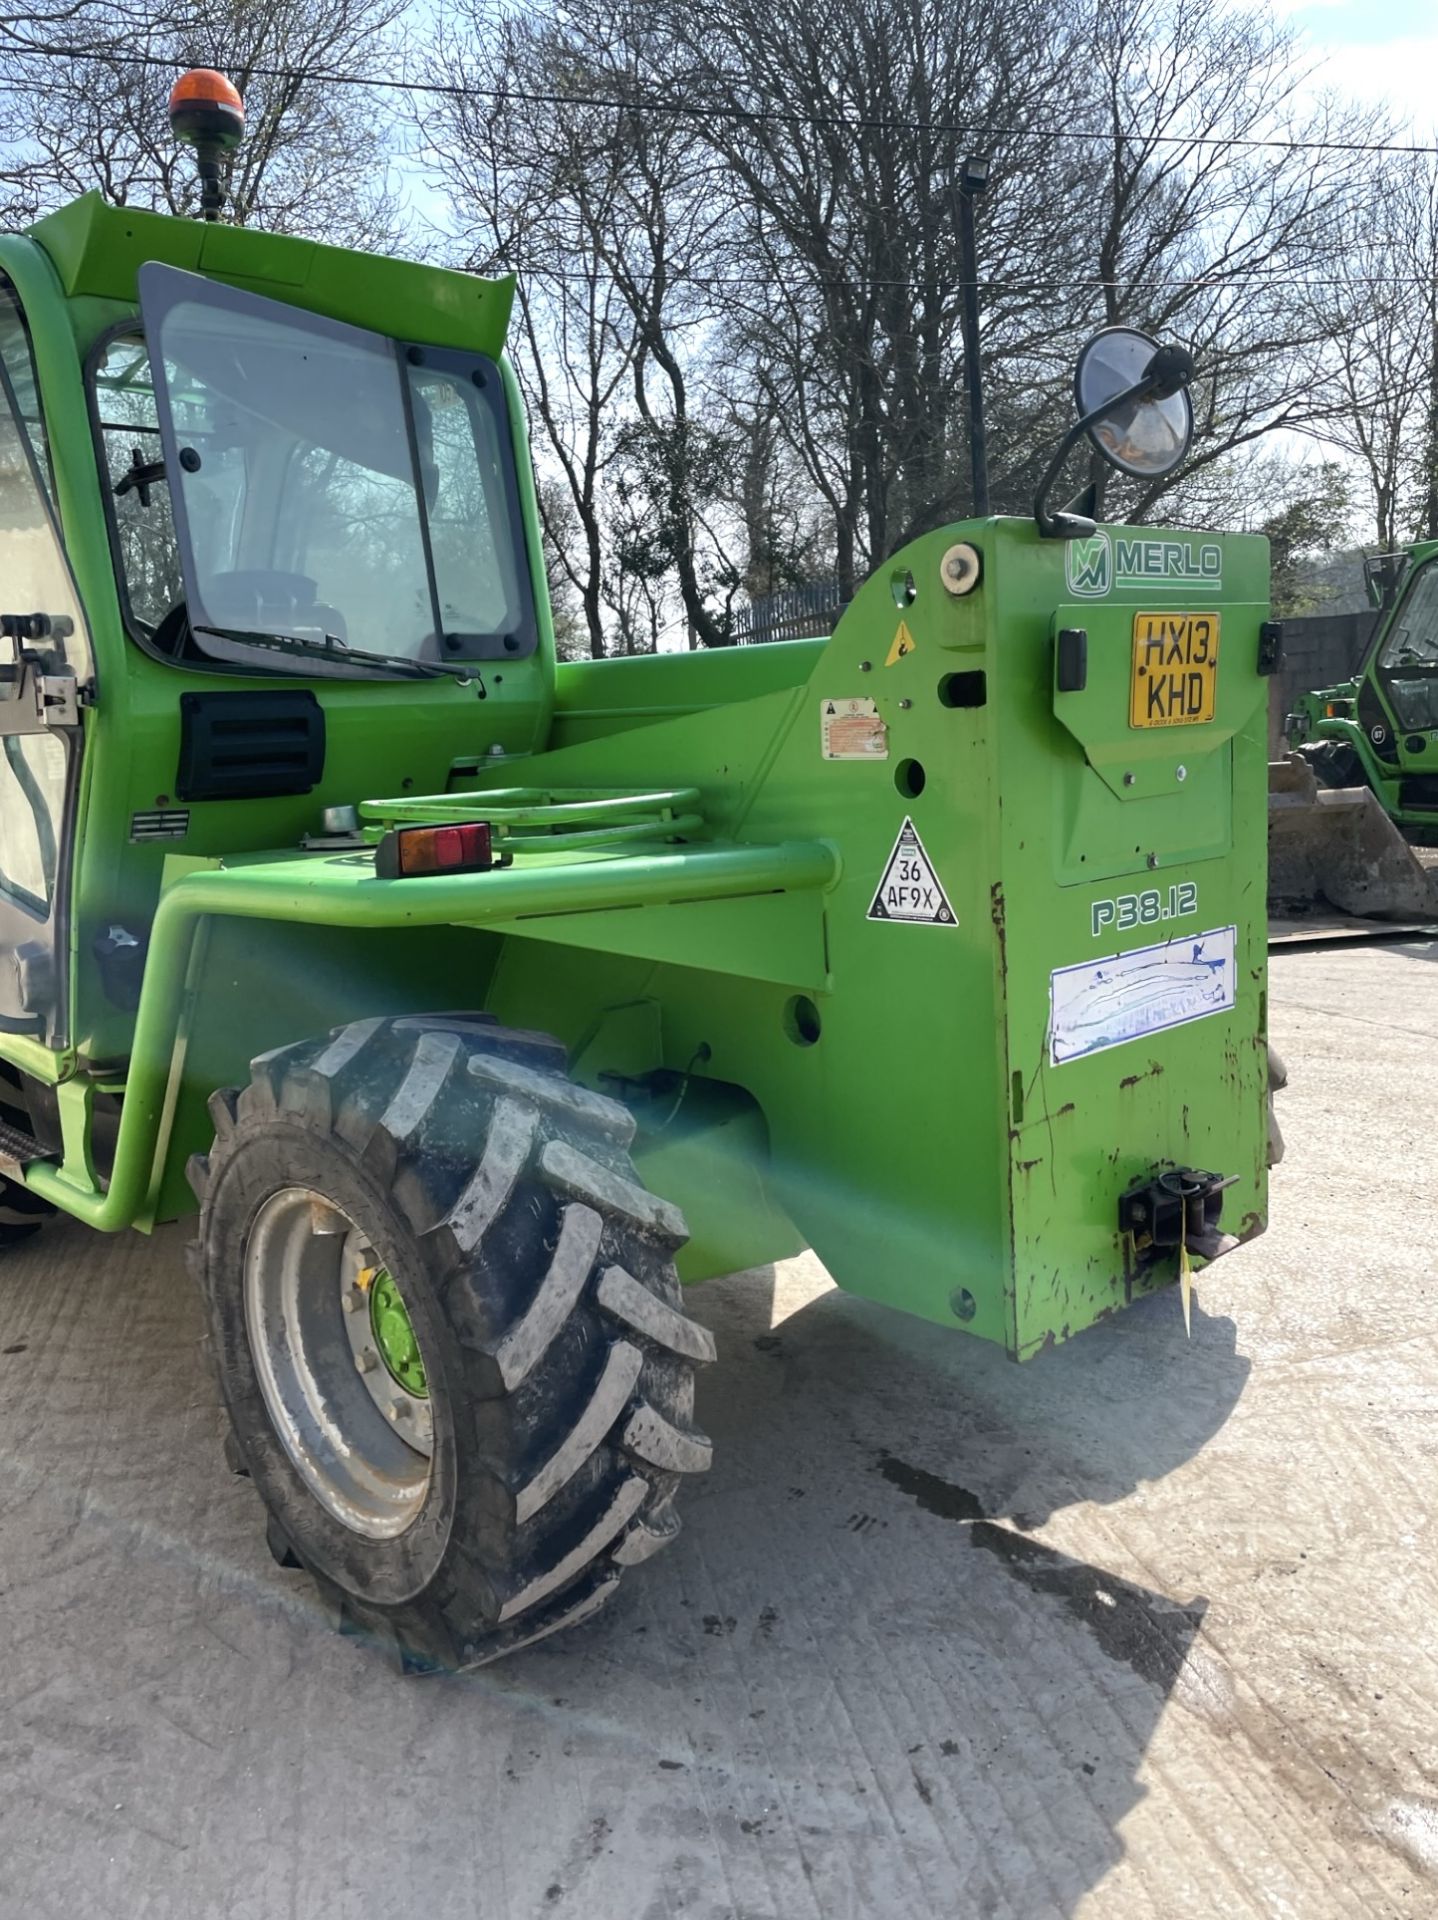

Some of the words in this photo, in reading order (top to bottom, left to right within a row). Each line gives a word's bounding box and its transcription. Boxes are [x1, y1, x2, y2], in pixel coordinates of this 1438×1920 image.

[1116, 539, 1222, 577] MERLO
[1145, 620, 1210, 666] HX13
[1147, 672, 1203, 719] KHD
[899, 860, 921, 882] 36
[887, 886, 933, 910] AF9X
[1091, 881, 1198, 937] P38.12
